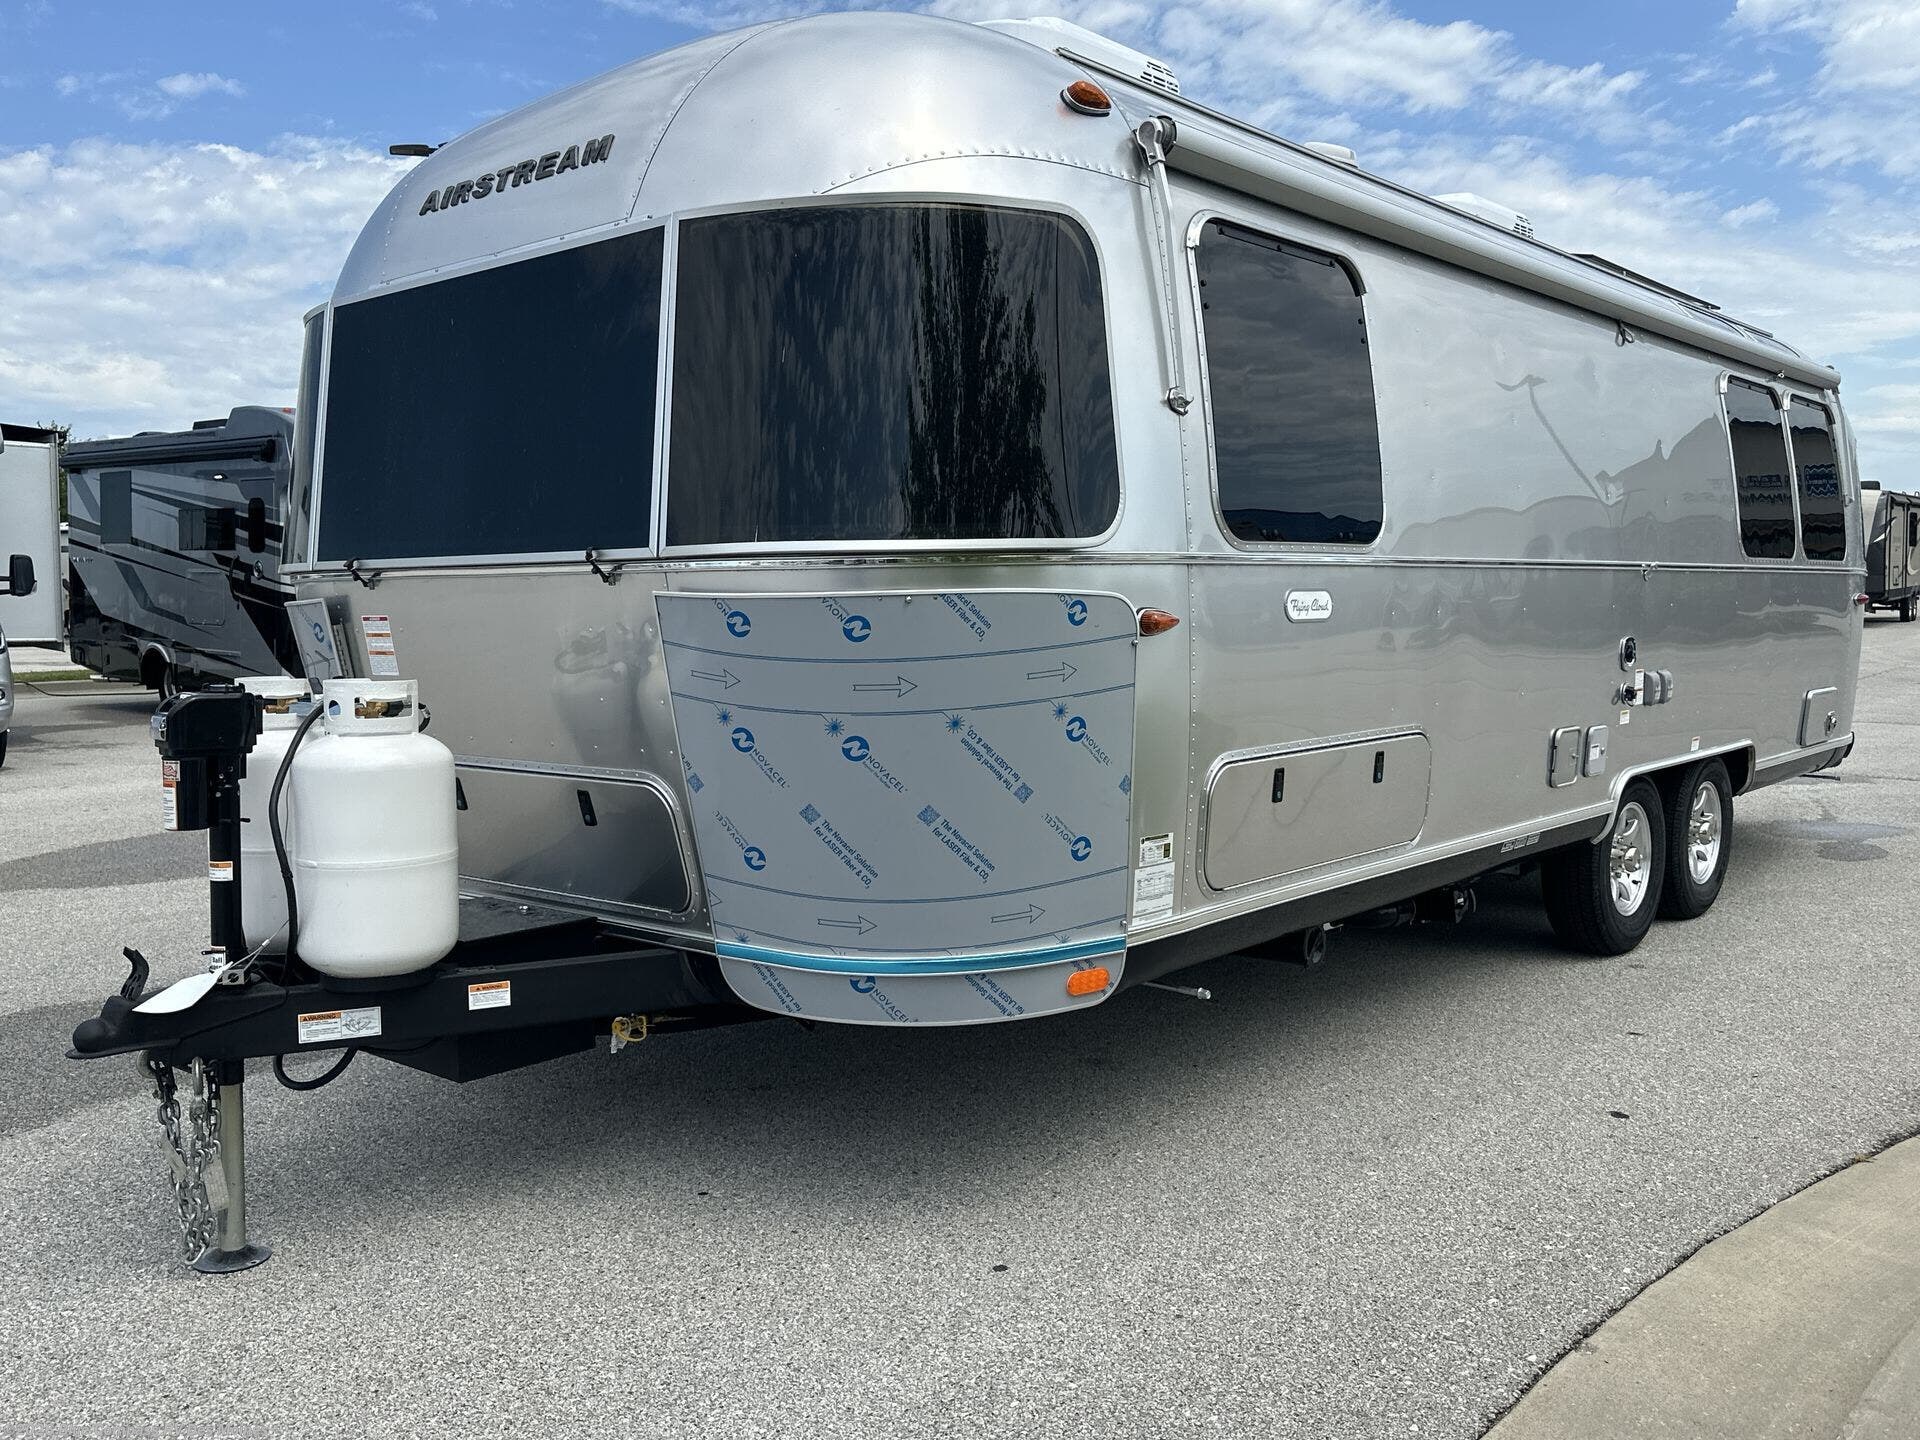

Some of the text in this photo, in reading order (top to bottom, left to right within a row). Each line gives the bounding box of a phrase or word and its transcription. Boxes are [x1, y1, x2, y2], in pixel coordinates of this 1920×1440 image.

[418, 133, 615, 216] AIRSTREAM
[955, 607, 972, 624] Fiber
[969, 604, 992, 630] Solution
[1290, 598, 1330, 616] Flying Cloud
[961, 738, 984, 761] Solution
[981, 743, 997, 758] Fiber
[1083, 734, 1111, 766] NOVACEL
[752, 749, 786, 789] NOVACEL
[866, 755, 904, 793] NOVACEL
[981, 758, 1004, 781] Novacel
[994, 755, 1014, 775] LASER
[714, 810, 746, 850] NOVACEL
[1044, 813, 1074, 845] NOVACEL
[813, 826, 824, 838] for
[822, 835, 843, 857] LASER
[840, 854, 857, 872] Fiber
[822, 819, 879, 879] The Novacel Solution
[932, 827, 943, 838] for
[941, 835, 962, 855] LASER
[960, 851, 976, 867] Fiber
[941, 819, 995, 872] The Novacel Solution
[965, 974, 1009, 1015] Novacel Solution
[985, 978, 1001, 993] Fiber
[793, 1001, 802, 1012] for
[998, 990, 1017, 1008] LASER
[1016, 1005, 1025, 1015] for
[308, 1012, 338, 1021] WARNING
